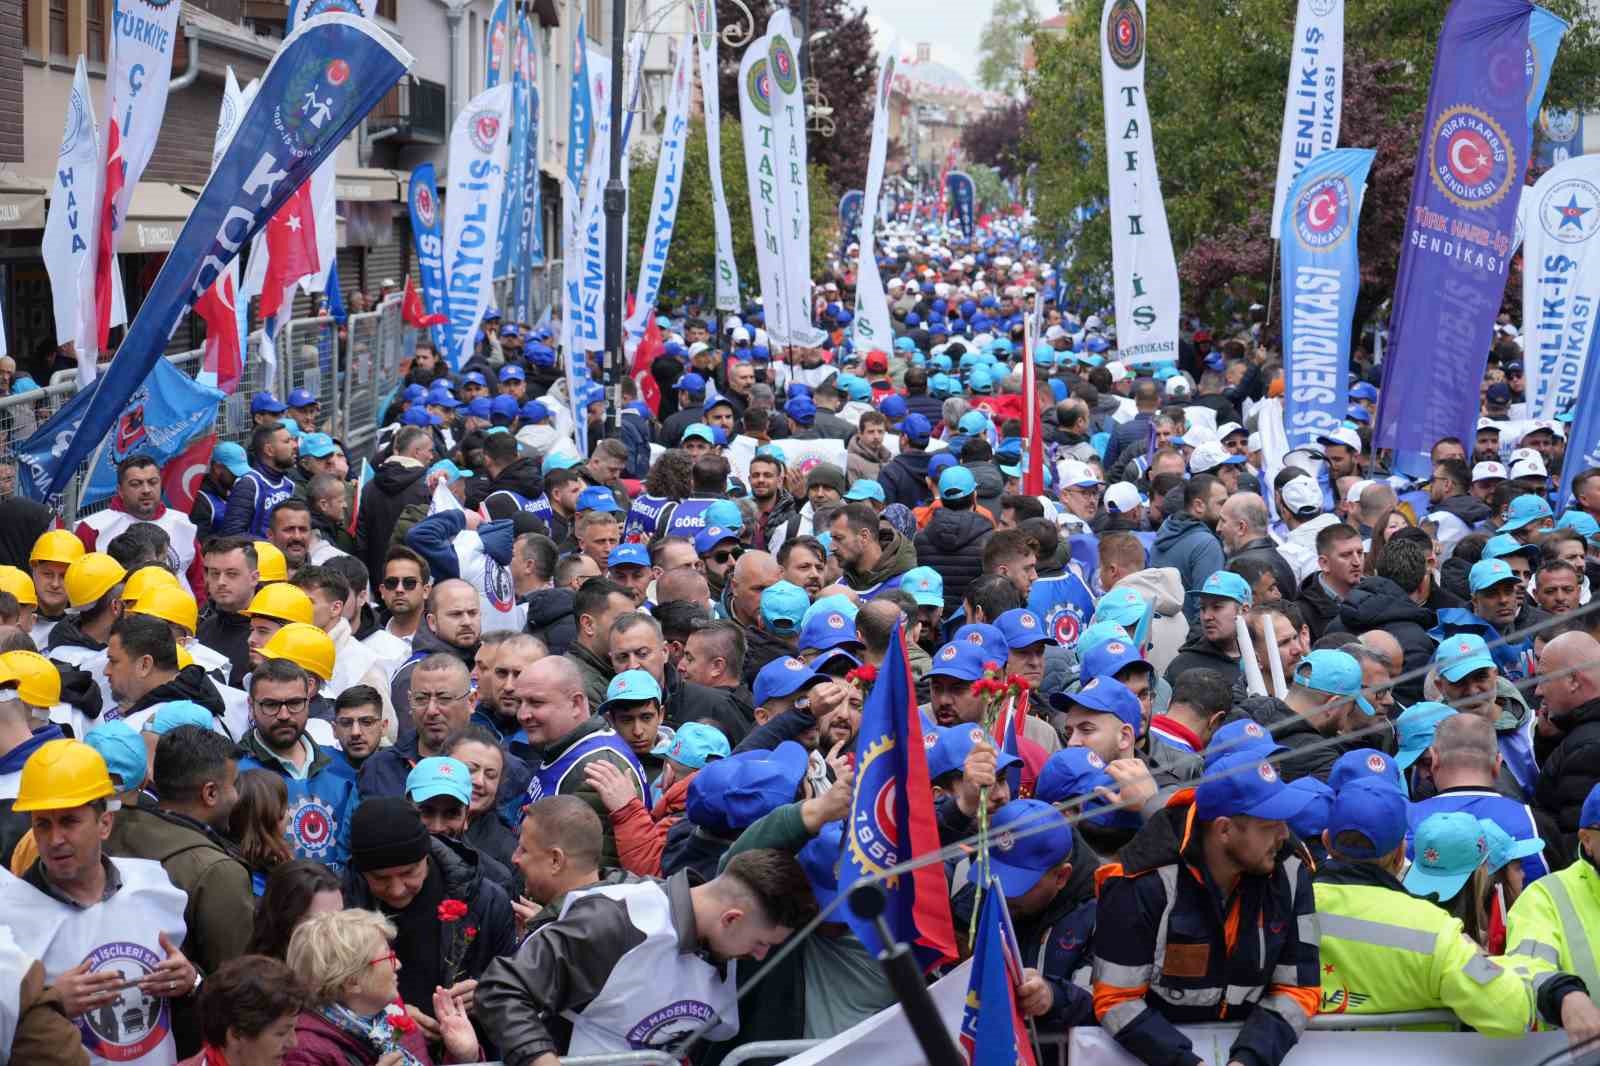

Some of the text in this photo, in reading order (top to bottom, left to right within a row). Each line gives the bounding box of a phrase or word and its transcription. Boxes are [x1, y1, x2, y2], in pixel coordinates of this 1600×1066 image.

[59, 167, 87, 253] HAVA
[1411, 230, 1504, 275] SENDİKASI
[675, 515, 706, 528] GÖRE
[857, 811, 897, 867] 1952
